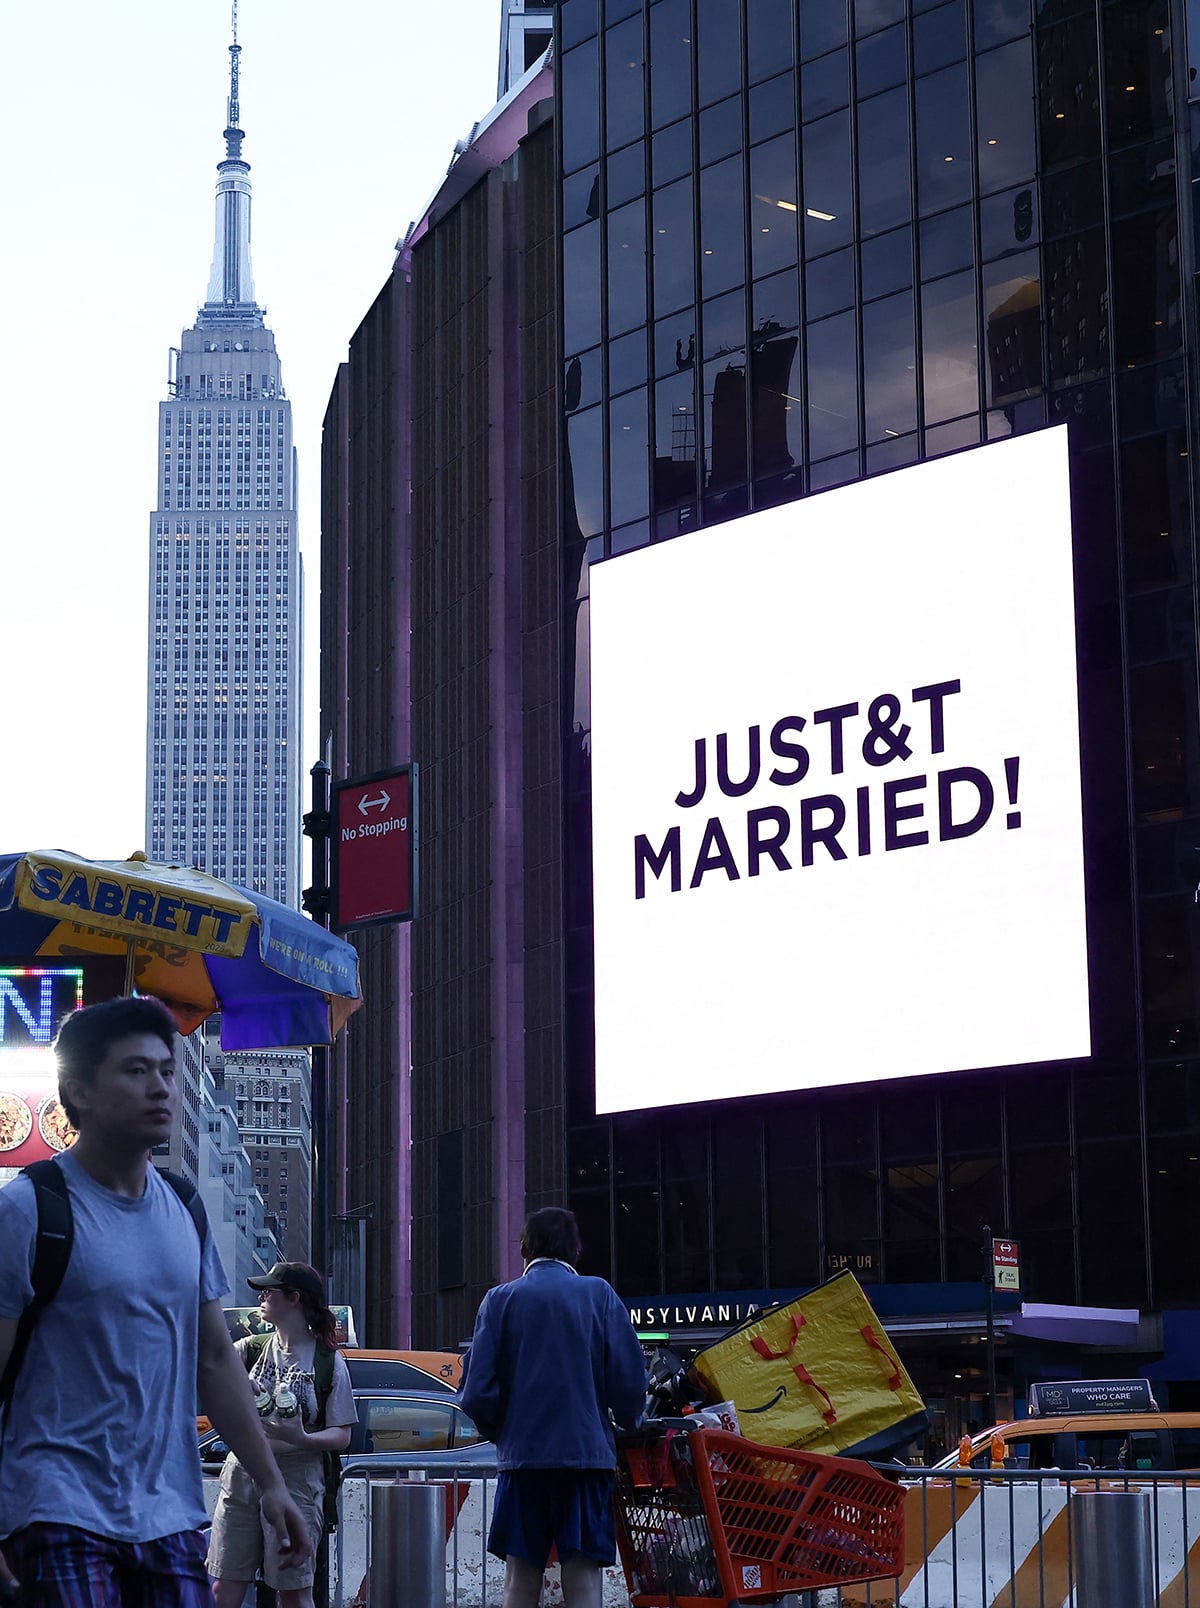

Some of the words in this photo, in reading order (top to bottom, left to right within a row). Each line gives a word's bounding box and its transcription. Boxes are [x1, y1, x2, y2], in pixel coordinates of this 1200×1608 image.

[675, 679, 960, 808] JUST&T
[341, 828, 356, 842] No
[358, 816, 408, 838] Stopping
[633, 756, 1022, 900] MARRIED!
[30, 863, 242, 944] SABRETT
[270, 938, 292, 957] WE'RE
[293, 948, 305, 962] ON
[306, 954, 312, 966] A
[314, 957, 334, 974] ROLL
[336, 964, 348, 978] !!!
